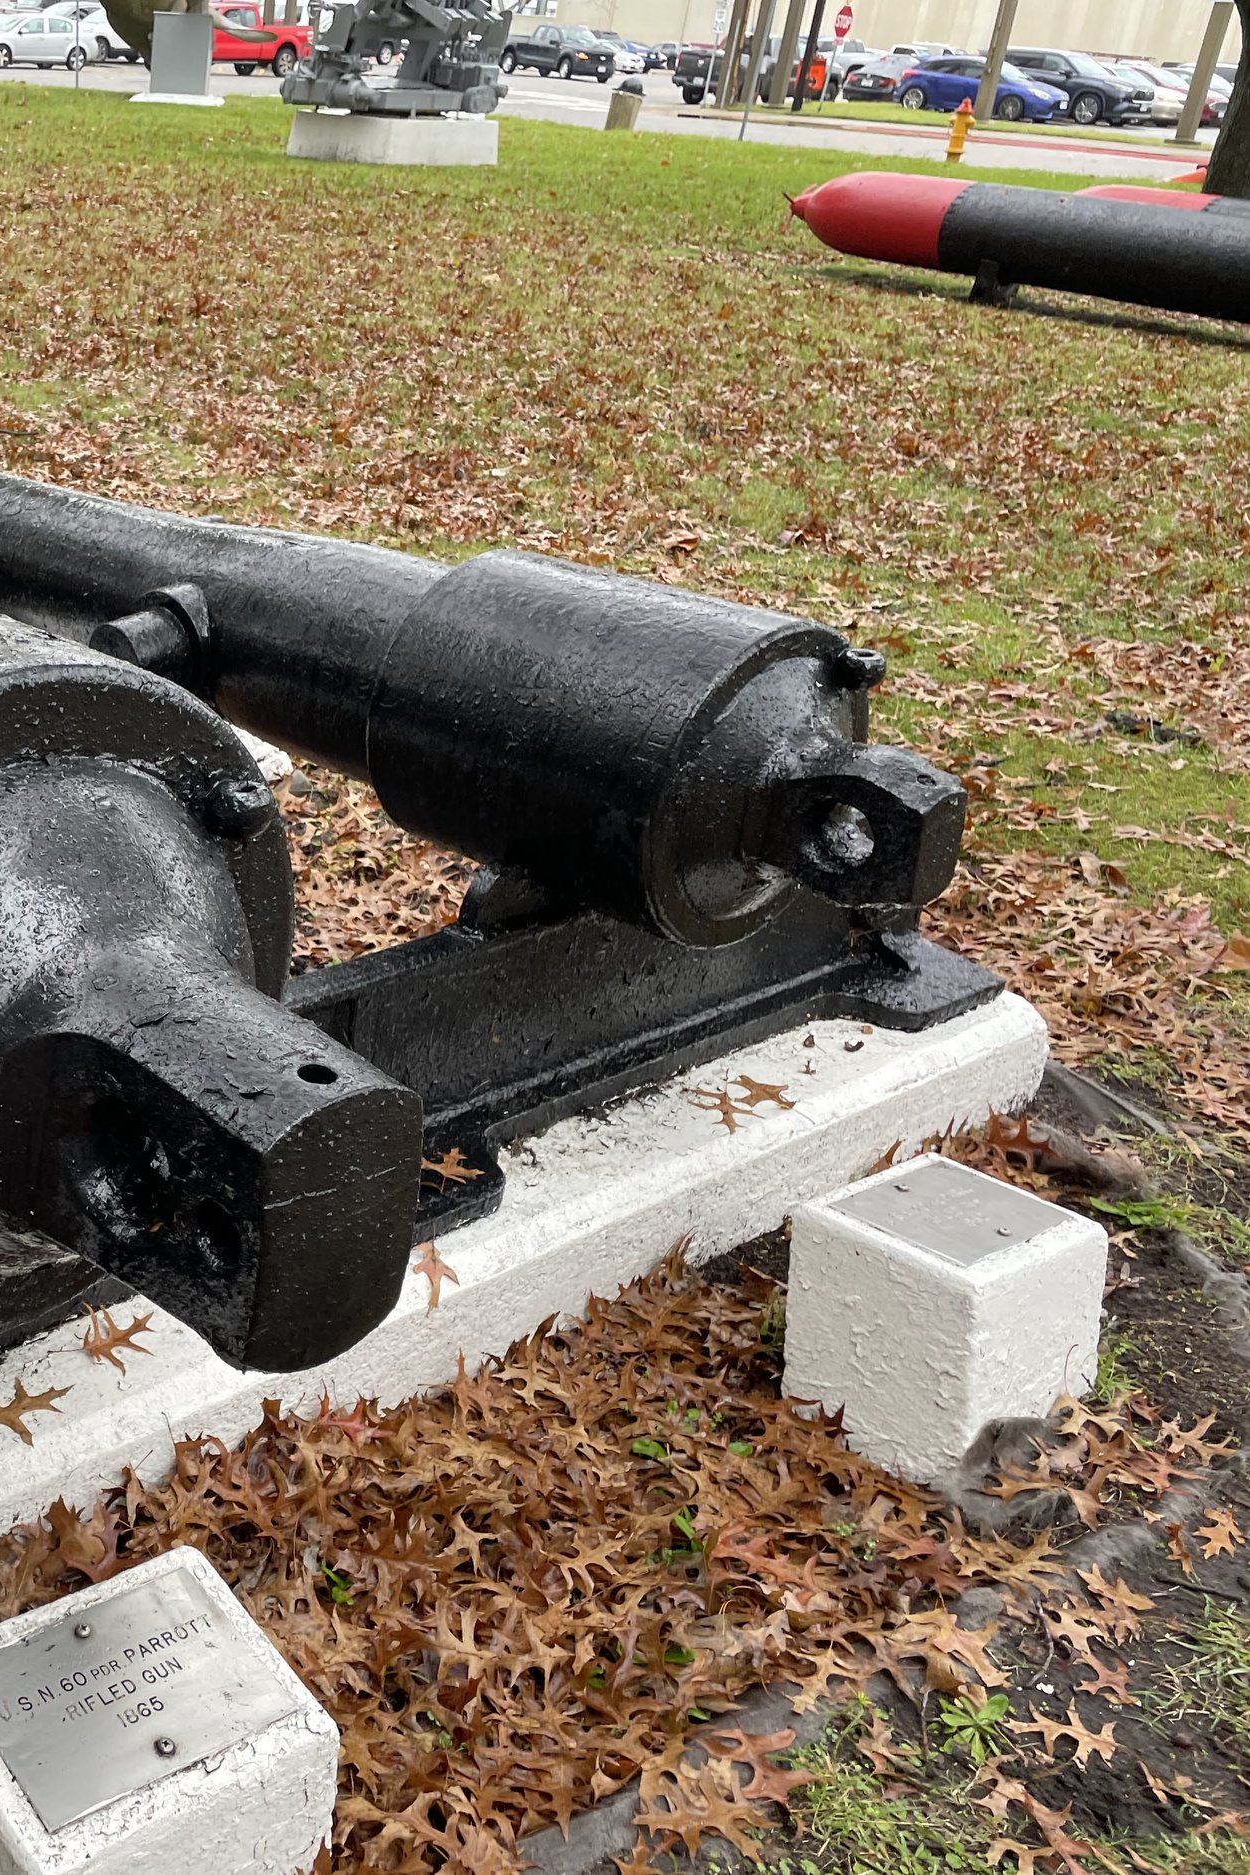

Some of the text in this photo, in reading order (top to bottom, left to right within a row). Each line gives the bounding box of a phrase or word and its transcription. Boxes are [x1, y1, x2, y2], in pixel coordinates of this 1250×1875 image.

[59, 1671, 87, 1692] 60
[122, 1613, 211, 1664] PARROTT
[64, 1656, 183, 1721] RIFLED GUN
[116, 1695, 165, 1728] 1865
